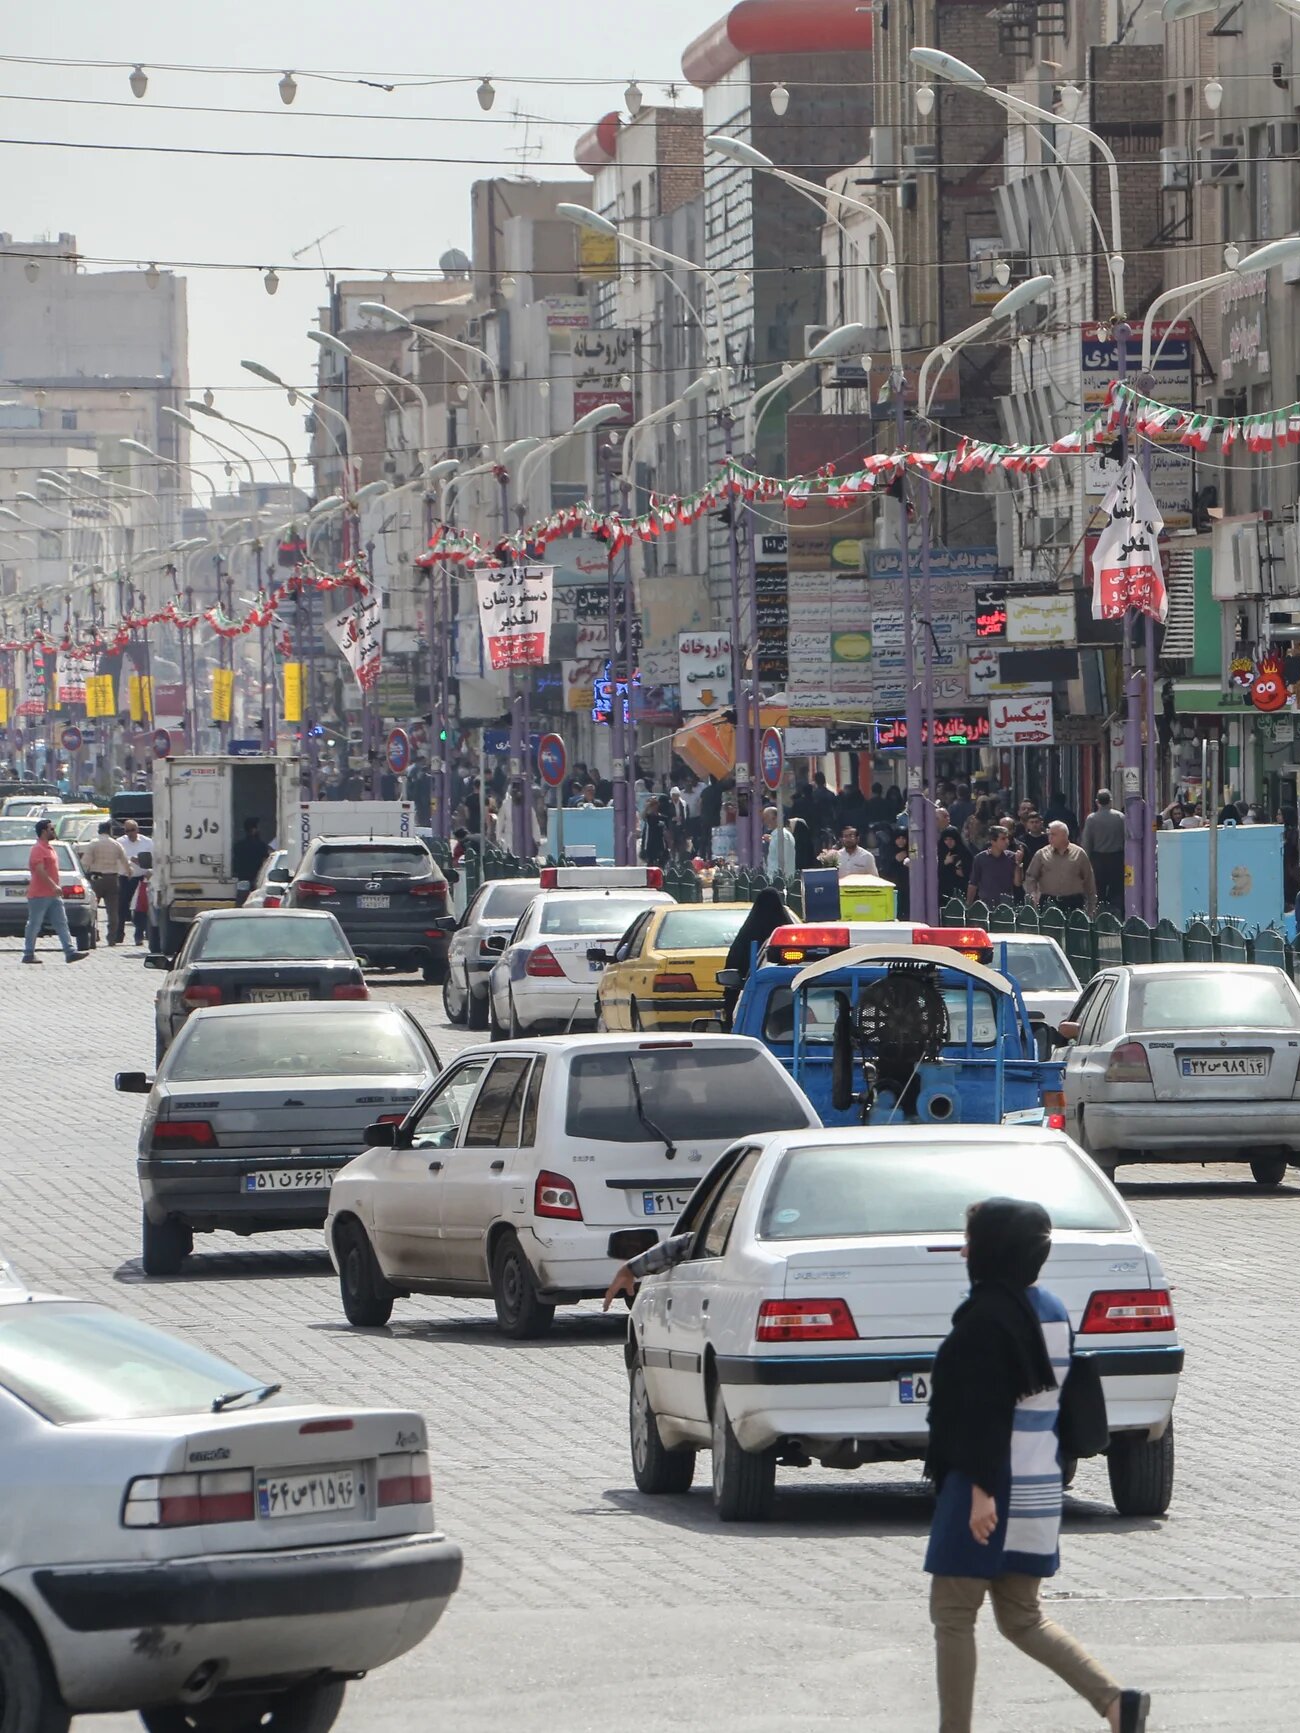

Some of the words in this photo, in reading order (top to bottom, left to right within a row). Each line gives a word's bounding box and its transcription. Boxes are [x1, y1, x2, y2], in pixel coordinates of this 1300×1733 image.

[574, 333, 628, 366] داروخانه
[488, 568, 544, 586] بازارچه
[482, 588, 548, 610] دستفروشان
[498, 610, 539, 632] الغدیر
[680, 638, 732, 658] داروخانه
[994, 704, 1048, 729] پیکسل
[945, 717, 990, 741] داروخانه
[183, 818, 220, 840] دارو
